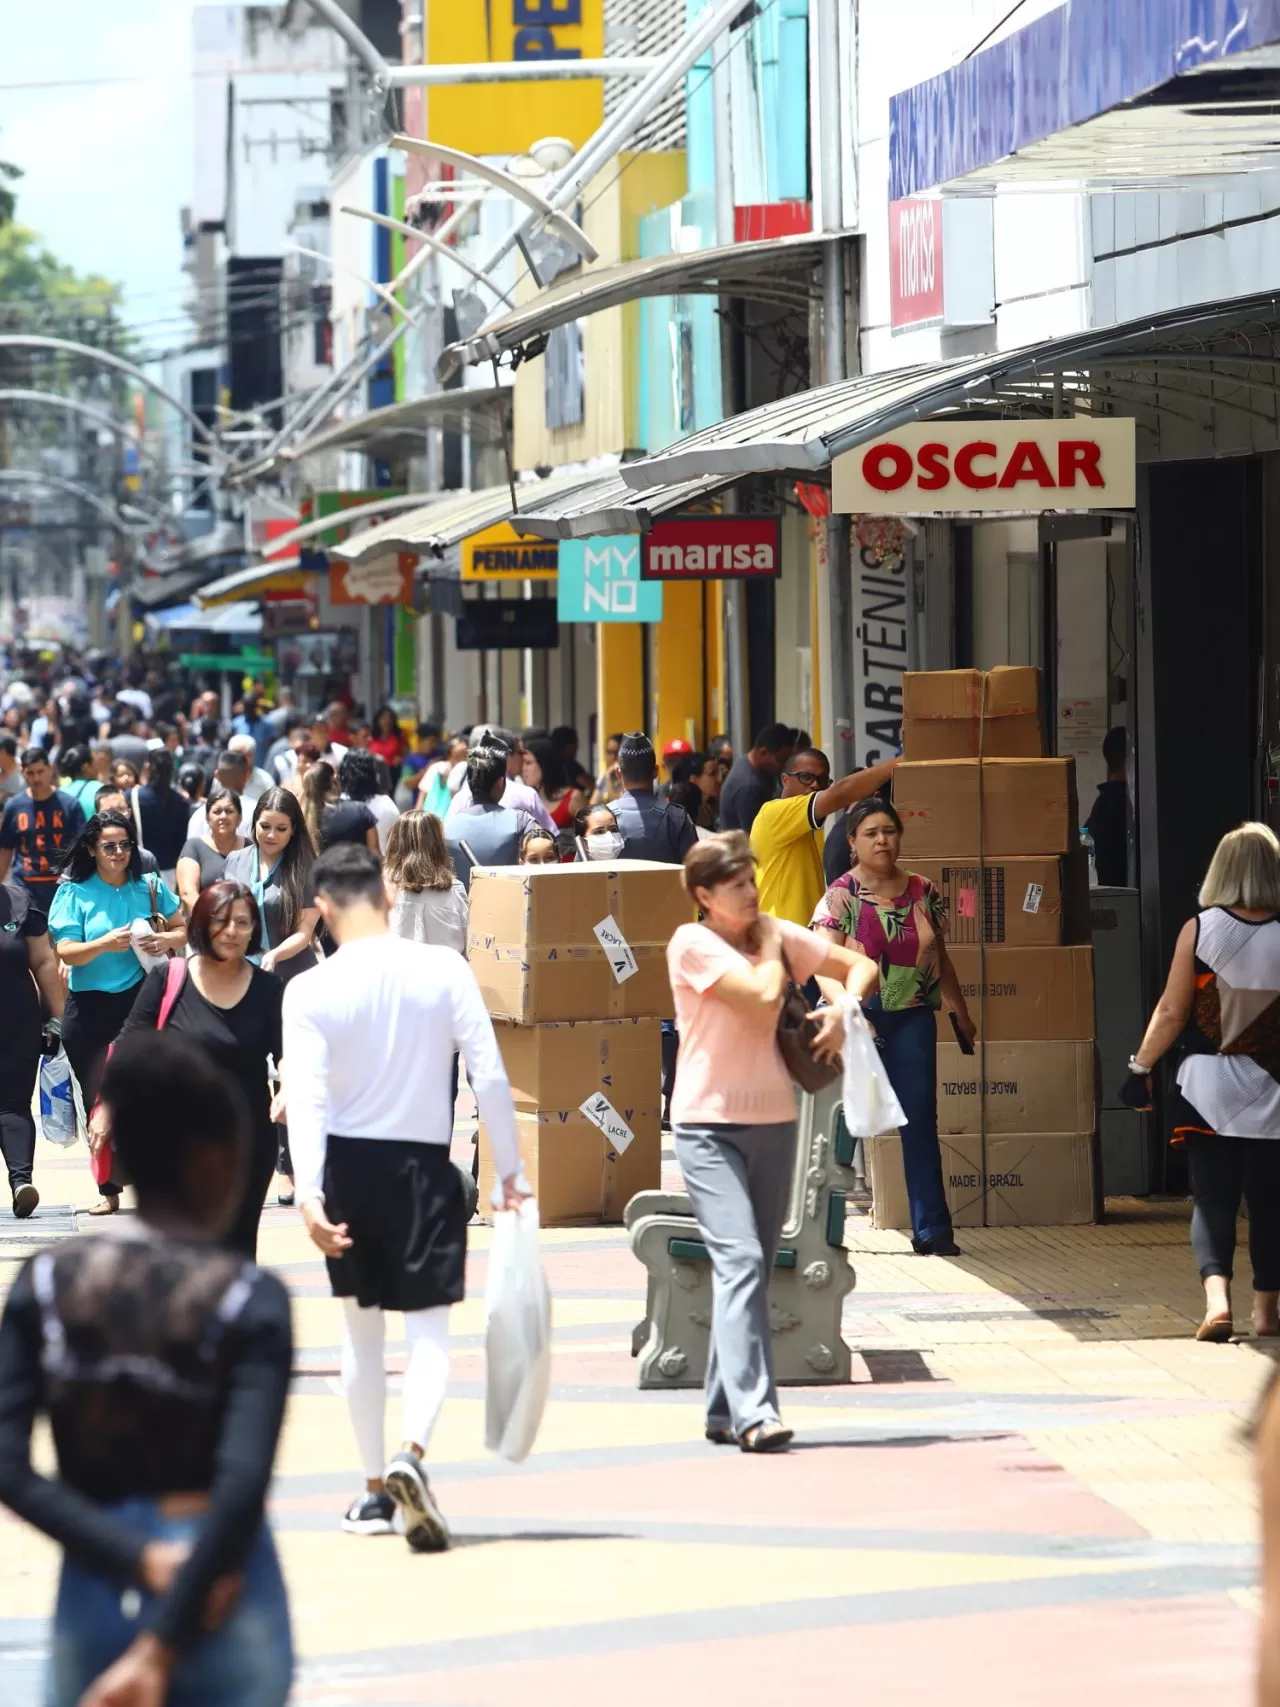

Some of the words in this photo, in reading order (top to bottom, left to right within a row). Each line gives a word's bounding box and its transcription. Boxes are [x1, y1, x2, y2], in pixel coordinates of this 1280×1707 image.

[900, 199, 935, 299] marisa
[862, 441, 1106, 491] OSCAR
[584, 545, 637, 578] MY
[649, 543, 774, 571] marisa
[584, 579, 637, 613] NO
[989, 983, 1017, 996] MADE
[942, 1082, 977, 1096] BRAZIL
[990, 1081, 1018, 1095] MADE
[608, 1125, 628, 1138] LACRE
[949, 1175, 977, 1188] MADE
[989, 1174, 1024, 1187] BRAZIL
